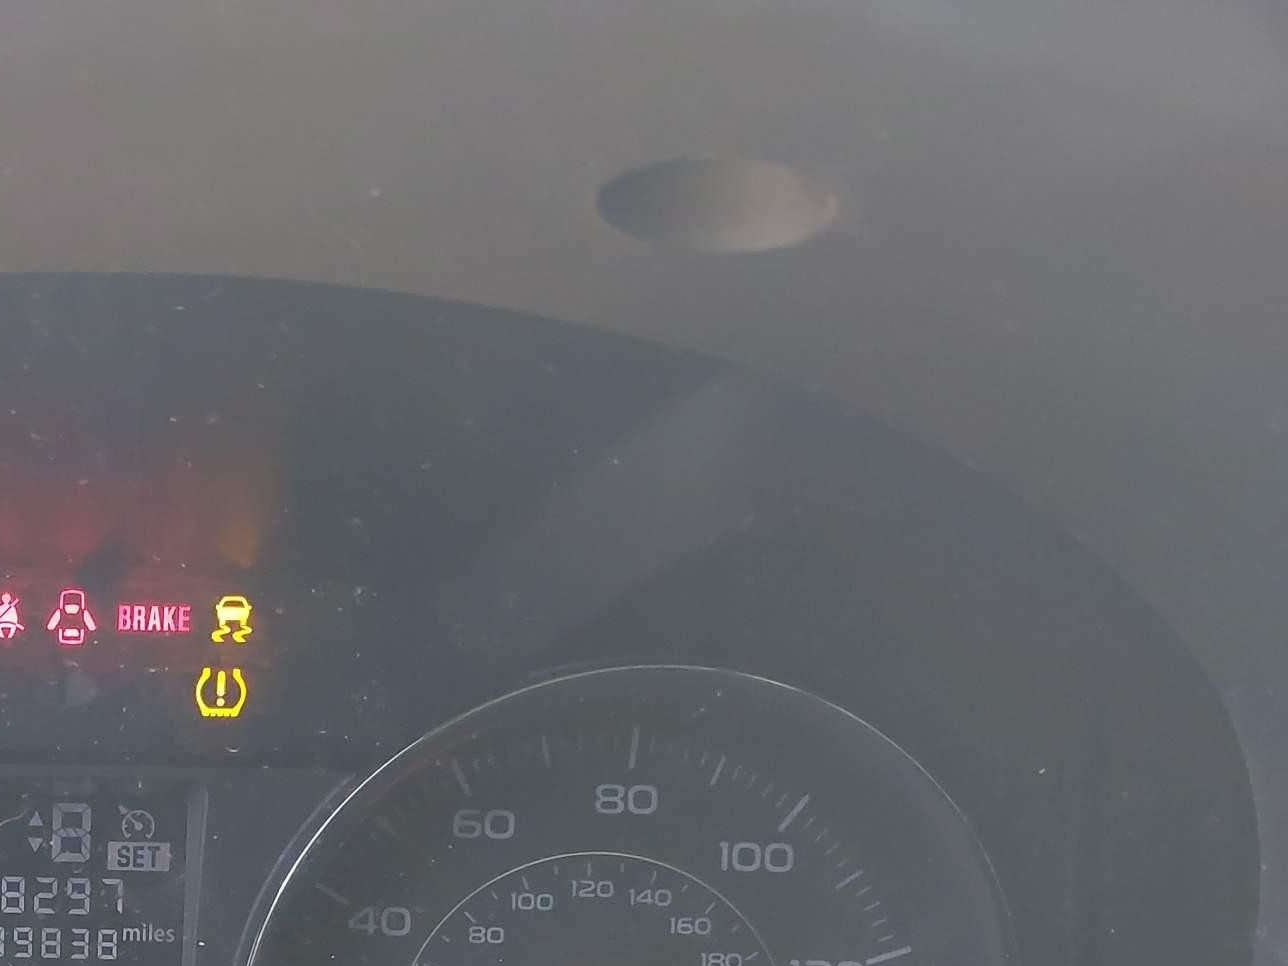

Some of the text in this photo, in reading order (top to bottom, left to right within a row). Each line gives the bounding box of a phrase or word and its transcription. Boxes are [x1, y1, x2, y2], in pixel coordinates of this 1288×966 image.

[117, 604, 192, 632] BRAKE
[594, 784, 659, 815] 80
[452, 809, 516, 840] 60
[114, 844, 163, 870] SET
[719, 841, 794, 873] 100
[0, 875, 124, 916] 8297
[511, 892, 555, 912] 100
[571, 879, 614, 899] 120
[629, 888, 672, 908] 140
[122, 923, 176, 944] miles
[348, 906, 412, 937] 40
[669, 917, 712, 936] 160
[468, 926, 505, 944] 80
